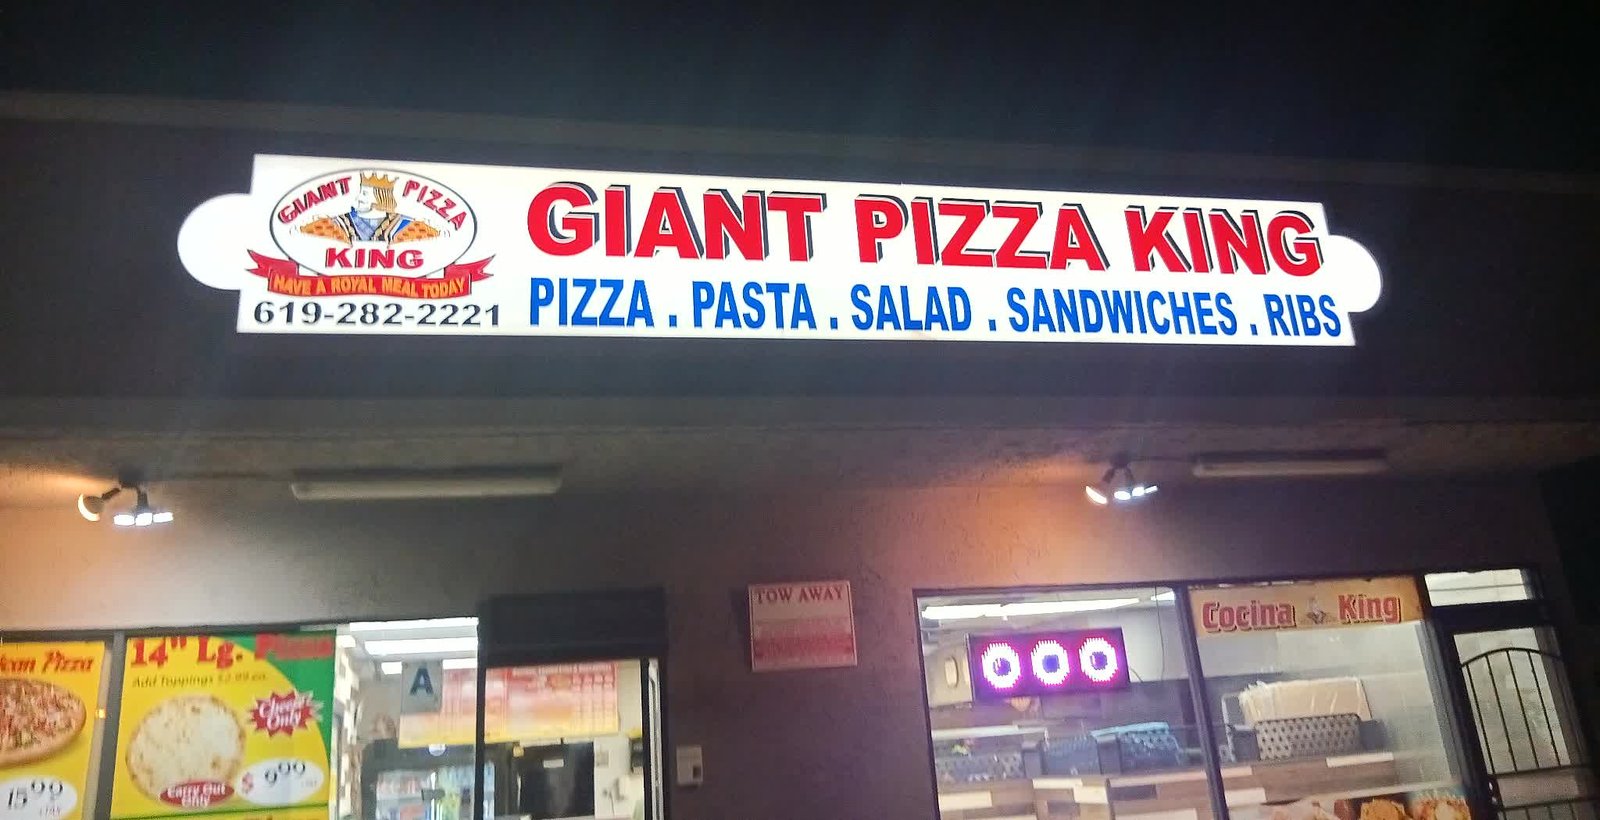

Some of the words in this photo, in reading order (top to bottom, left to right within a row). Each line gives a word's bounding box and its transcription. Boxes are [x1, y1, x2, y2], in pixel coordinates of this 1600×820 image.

[277, 176, 352, 224] GIANT
[402, 179, 467, 232] PIZZA
[527, 181, 826, 262] GIANT
[854, 194, 1111, 271] PIZZA
[1124, 205, 1324, 277] KING
[325, 247, 425, 270] KING
[272, 274, 312, 296] HAVE
[316, 277, 327, 295] A
[331, 275, 377, 294] ROYAL
[381, 276, 419, 296] MEAL
[421, 276, 467, 299] TODAY
[253, 301, 500, 327] 619-282-2221
[530, 277, 655, 328] PIZZA
[692, 280, 818, 330] PASTA
[850, 284, 971, 332] SALAD
[1007, 287, 1238, 336] SANDWICHES
[1263, 293, 1341, 337] RIBS
[756, 587, 793, 604] TOW
[799, 586, 843, 602] AWAY
[1203, 600, 1296, 633] Cocina
[1339, 594, 1401, 624] King
[409, 665, 434, 696] A
[266, 709, 302, 731] Only
